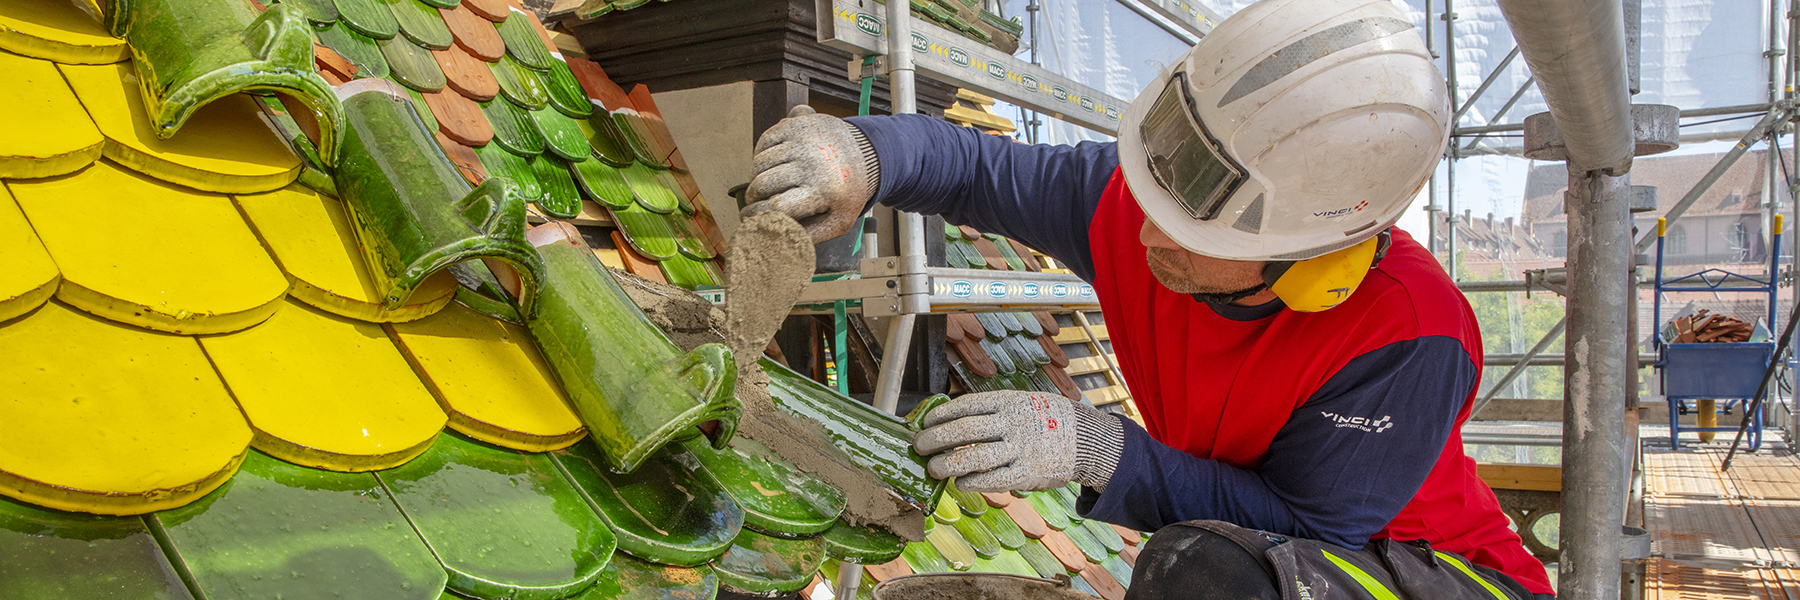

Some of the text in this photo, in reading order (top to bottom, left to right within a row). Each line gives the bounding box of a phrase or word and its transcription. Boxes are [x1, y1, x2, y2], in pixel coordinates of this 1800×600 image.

[858, 16, 881, 33] MACC
[950, 50, 968, 64] MACC
[989, 64, 1005, 78] MACC
[1053, 90, 1067, 100] MACC
[1106, 108, 1118, 118] MACC
[1313, 208, 1351, 217] VINCI
[954, 284, 971, 294] MACC
[991, 285, 1006, 294] MACC
[1024, 285, 1038, 294] MACC
[1053, 285, 1066, 294] MACC
[1081, 285, 1093, 294] MACC
[1321, 411, 1370, 426] VINCI
